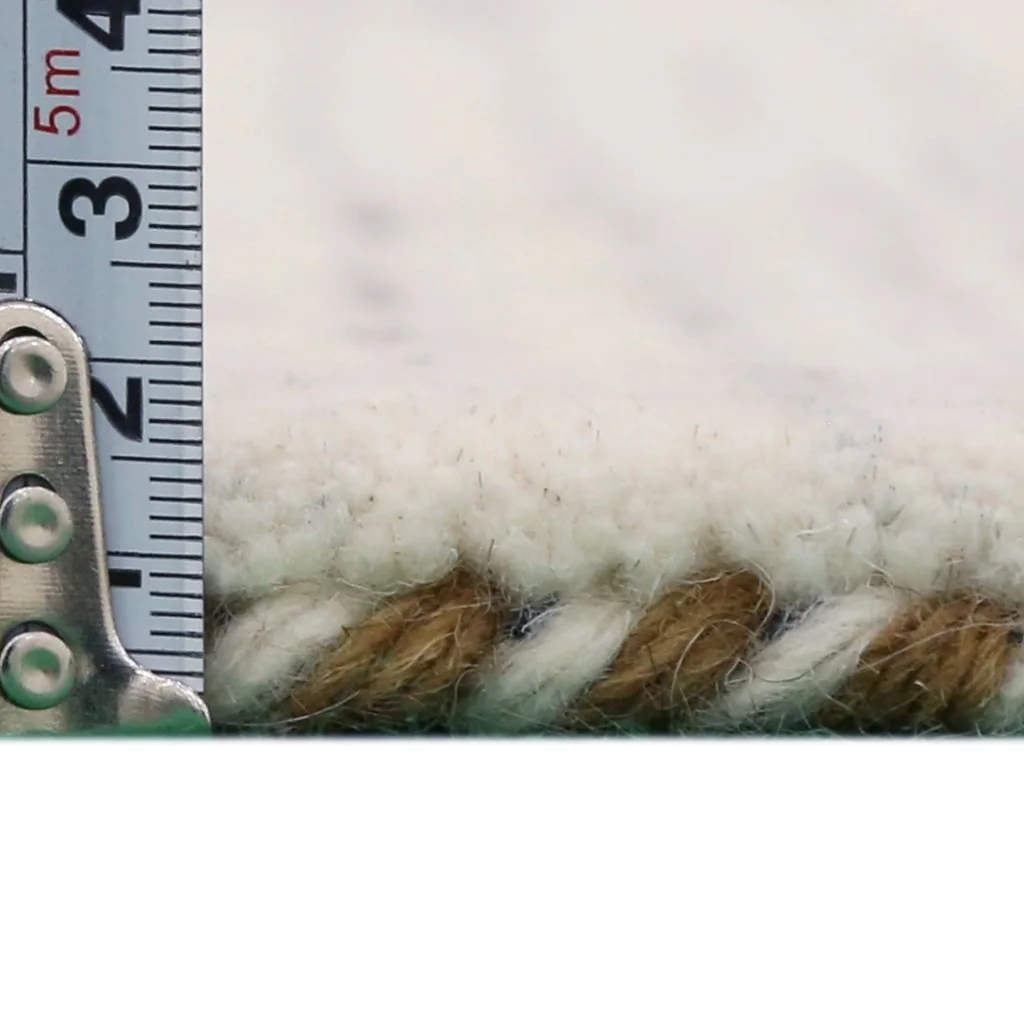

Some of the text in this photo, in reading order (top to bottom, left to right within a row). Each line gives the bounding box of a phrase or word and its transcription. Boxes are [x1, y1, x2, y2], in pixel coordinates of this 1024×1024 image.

[33, 48, 81, 136] 5m
[58, 176, 143, 241] 3
[90, 377, 143, 442] 2
